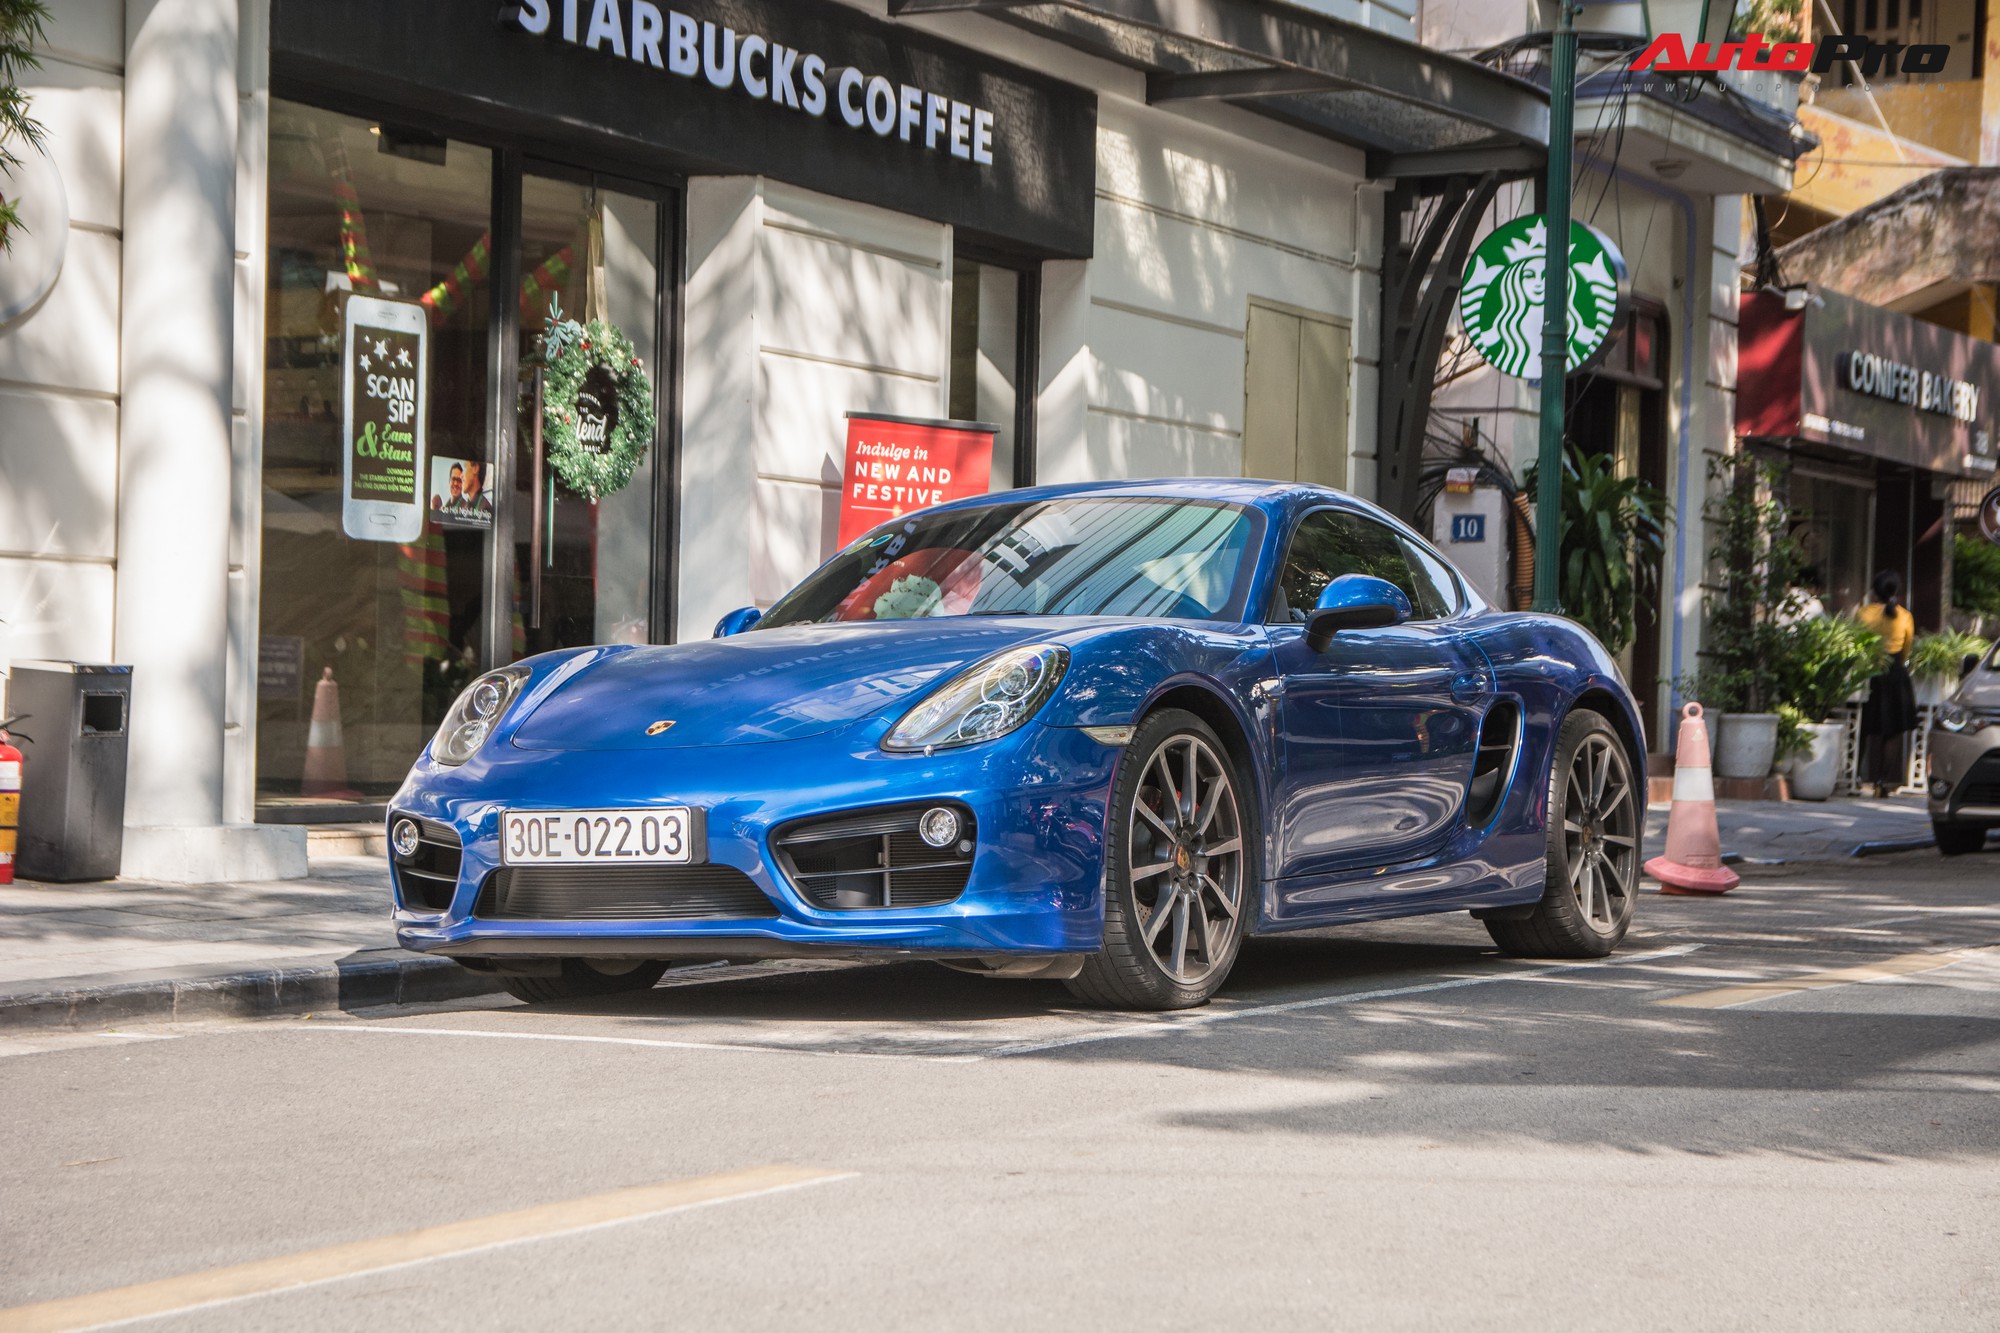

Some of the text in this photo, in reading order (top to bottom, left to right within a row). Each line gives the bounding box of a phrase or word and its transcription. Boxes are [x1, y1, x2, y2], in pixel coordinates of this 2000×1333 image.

[838, 66, 994, 165] COFFEE
[367, 374, 415, 401] SCAN
[1850, 350, 1980, 422] CONIFER BAKERY
[388, 400, 415, 424] SIP
[356, 421, 413, 458] & Earn
[575, 413, 608, 442] lend
[856, 441, 929, 461] Indulge in
[855, 461, 951, 484] NEW AND
[853, 483, 943, 505] FESTIVE
[1459, 517, 1478, 538] 10
[510, 815, 683, 858] 30E-022.03
